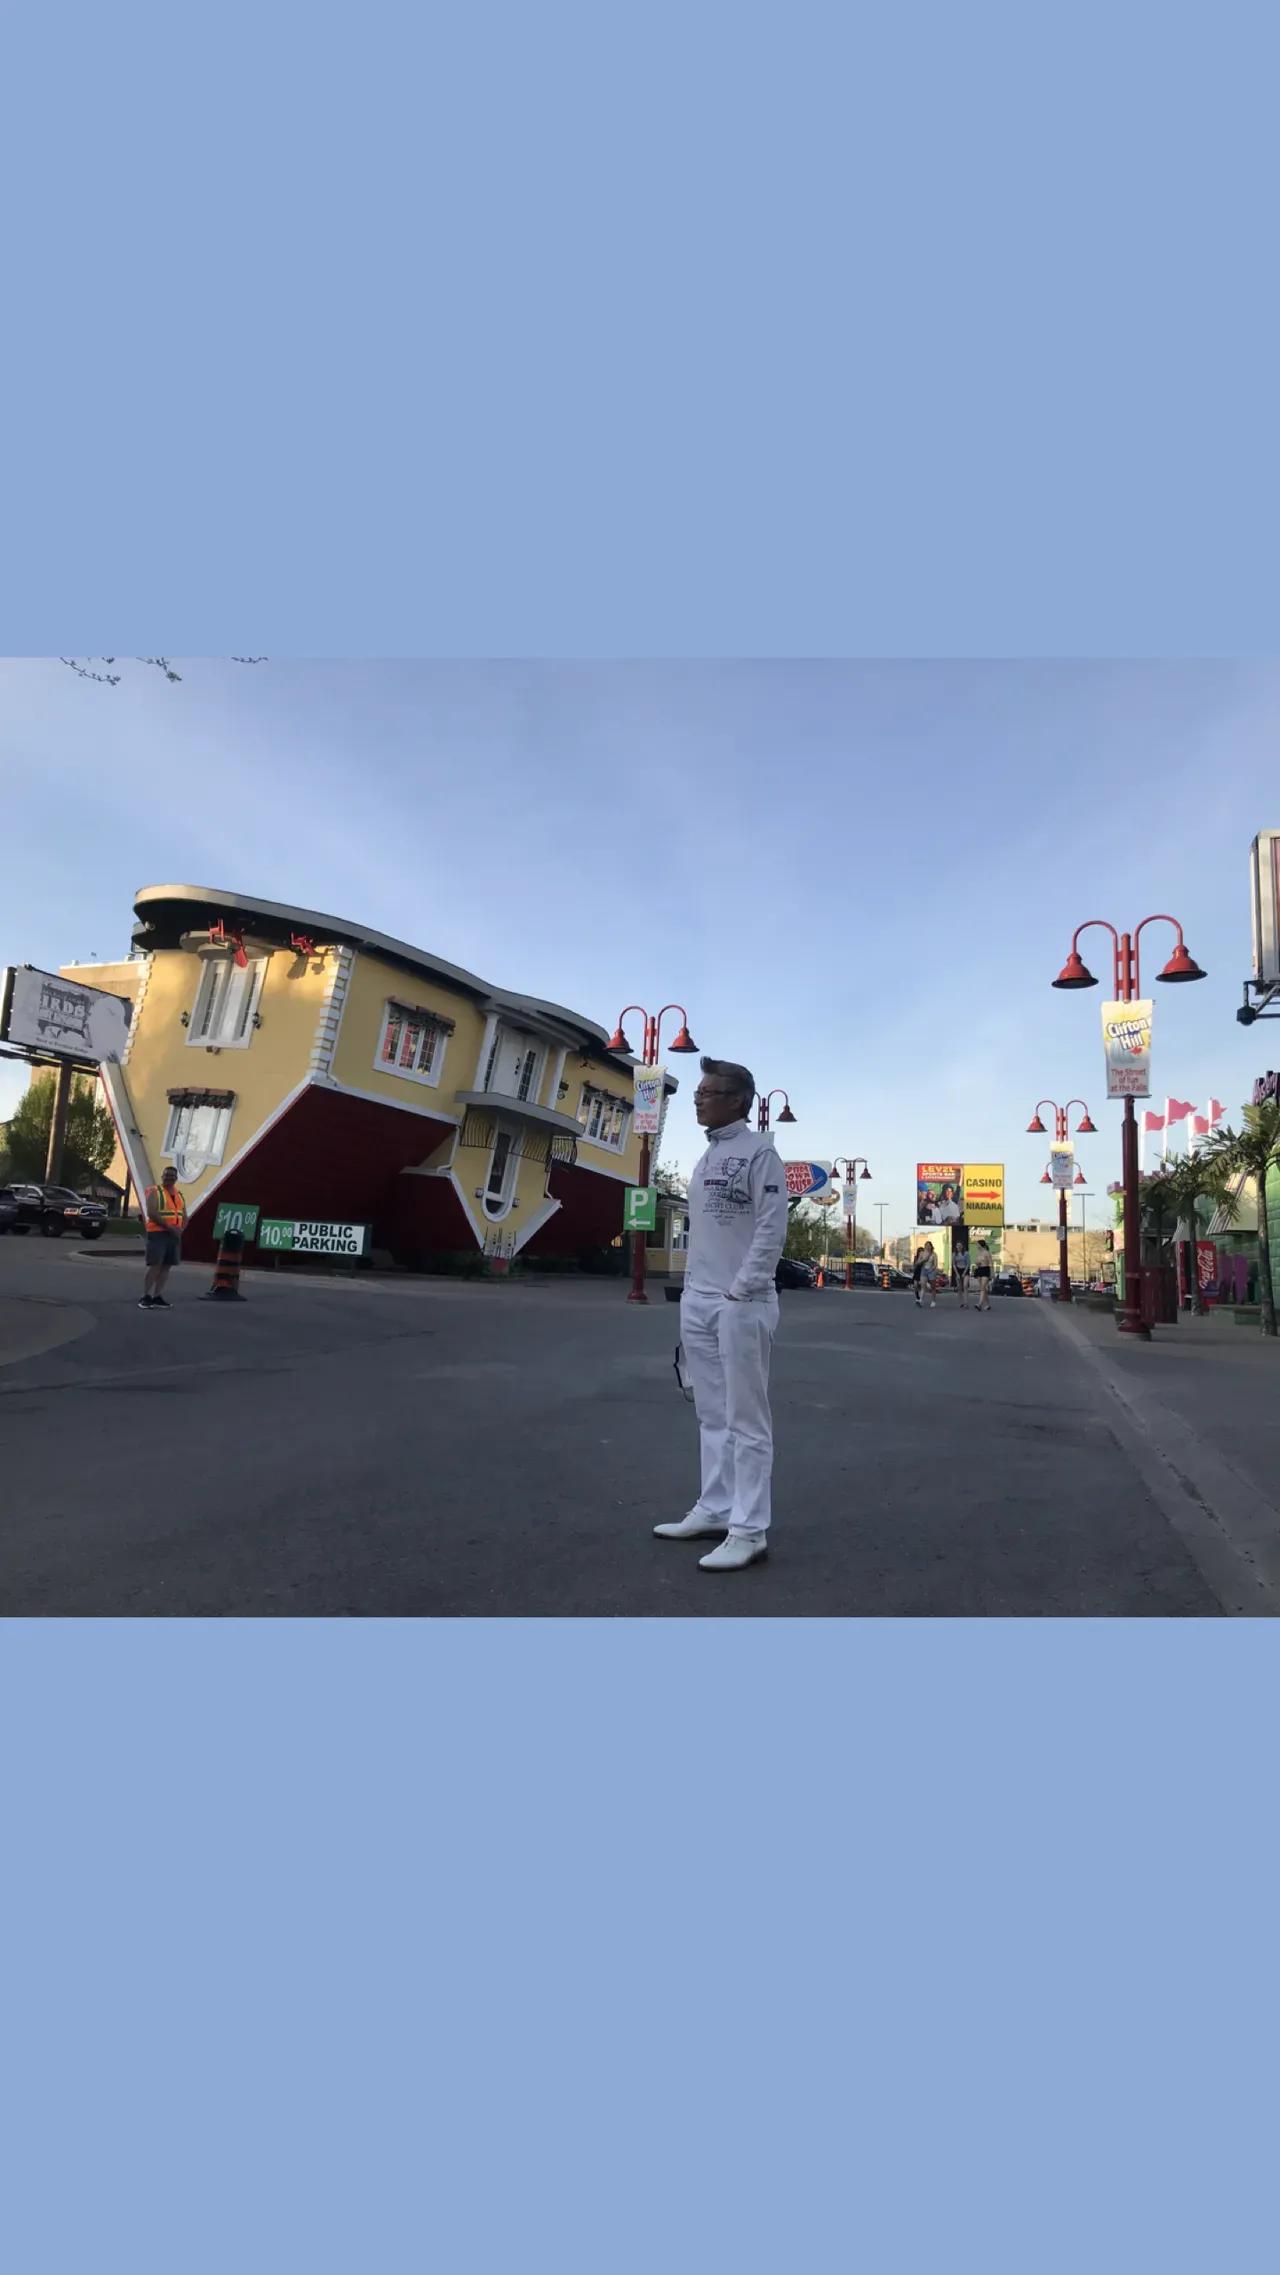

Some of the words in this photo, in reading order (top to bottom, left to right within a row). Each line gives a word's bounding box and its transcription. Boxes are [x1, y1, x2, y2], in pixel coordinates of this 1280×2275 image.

[1107, 1018, 1149, 1038] Clifton
[1120, 1032, 1145, 1050] Hill
[1111, 1068, 1123, 1076] The
[1125, 1067, 1146, 1076] Street
[636, 1079, 661, 1093] Clifton
[642, 1088, 657, 1101] Hill
[966, 1179, 1002, 1187] CASINO
[630, 1190, 648, 1216] P
[966, 1202, 1002, 1210] NIAGARA
[217, 1209, 257, 1233] $10.00
[261, 1224, 292, 1246] $10.00
[299, 1224, 353, 1238] PUBLIC
[292, 1236, 358, 1253] PARKING
